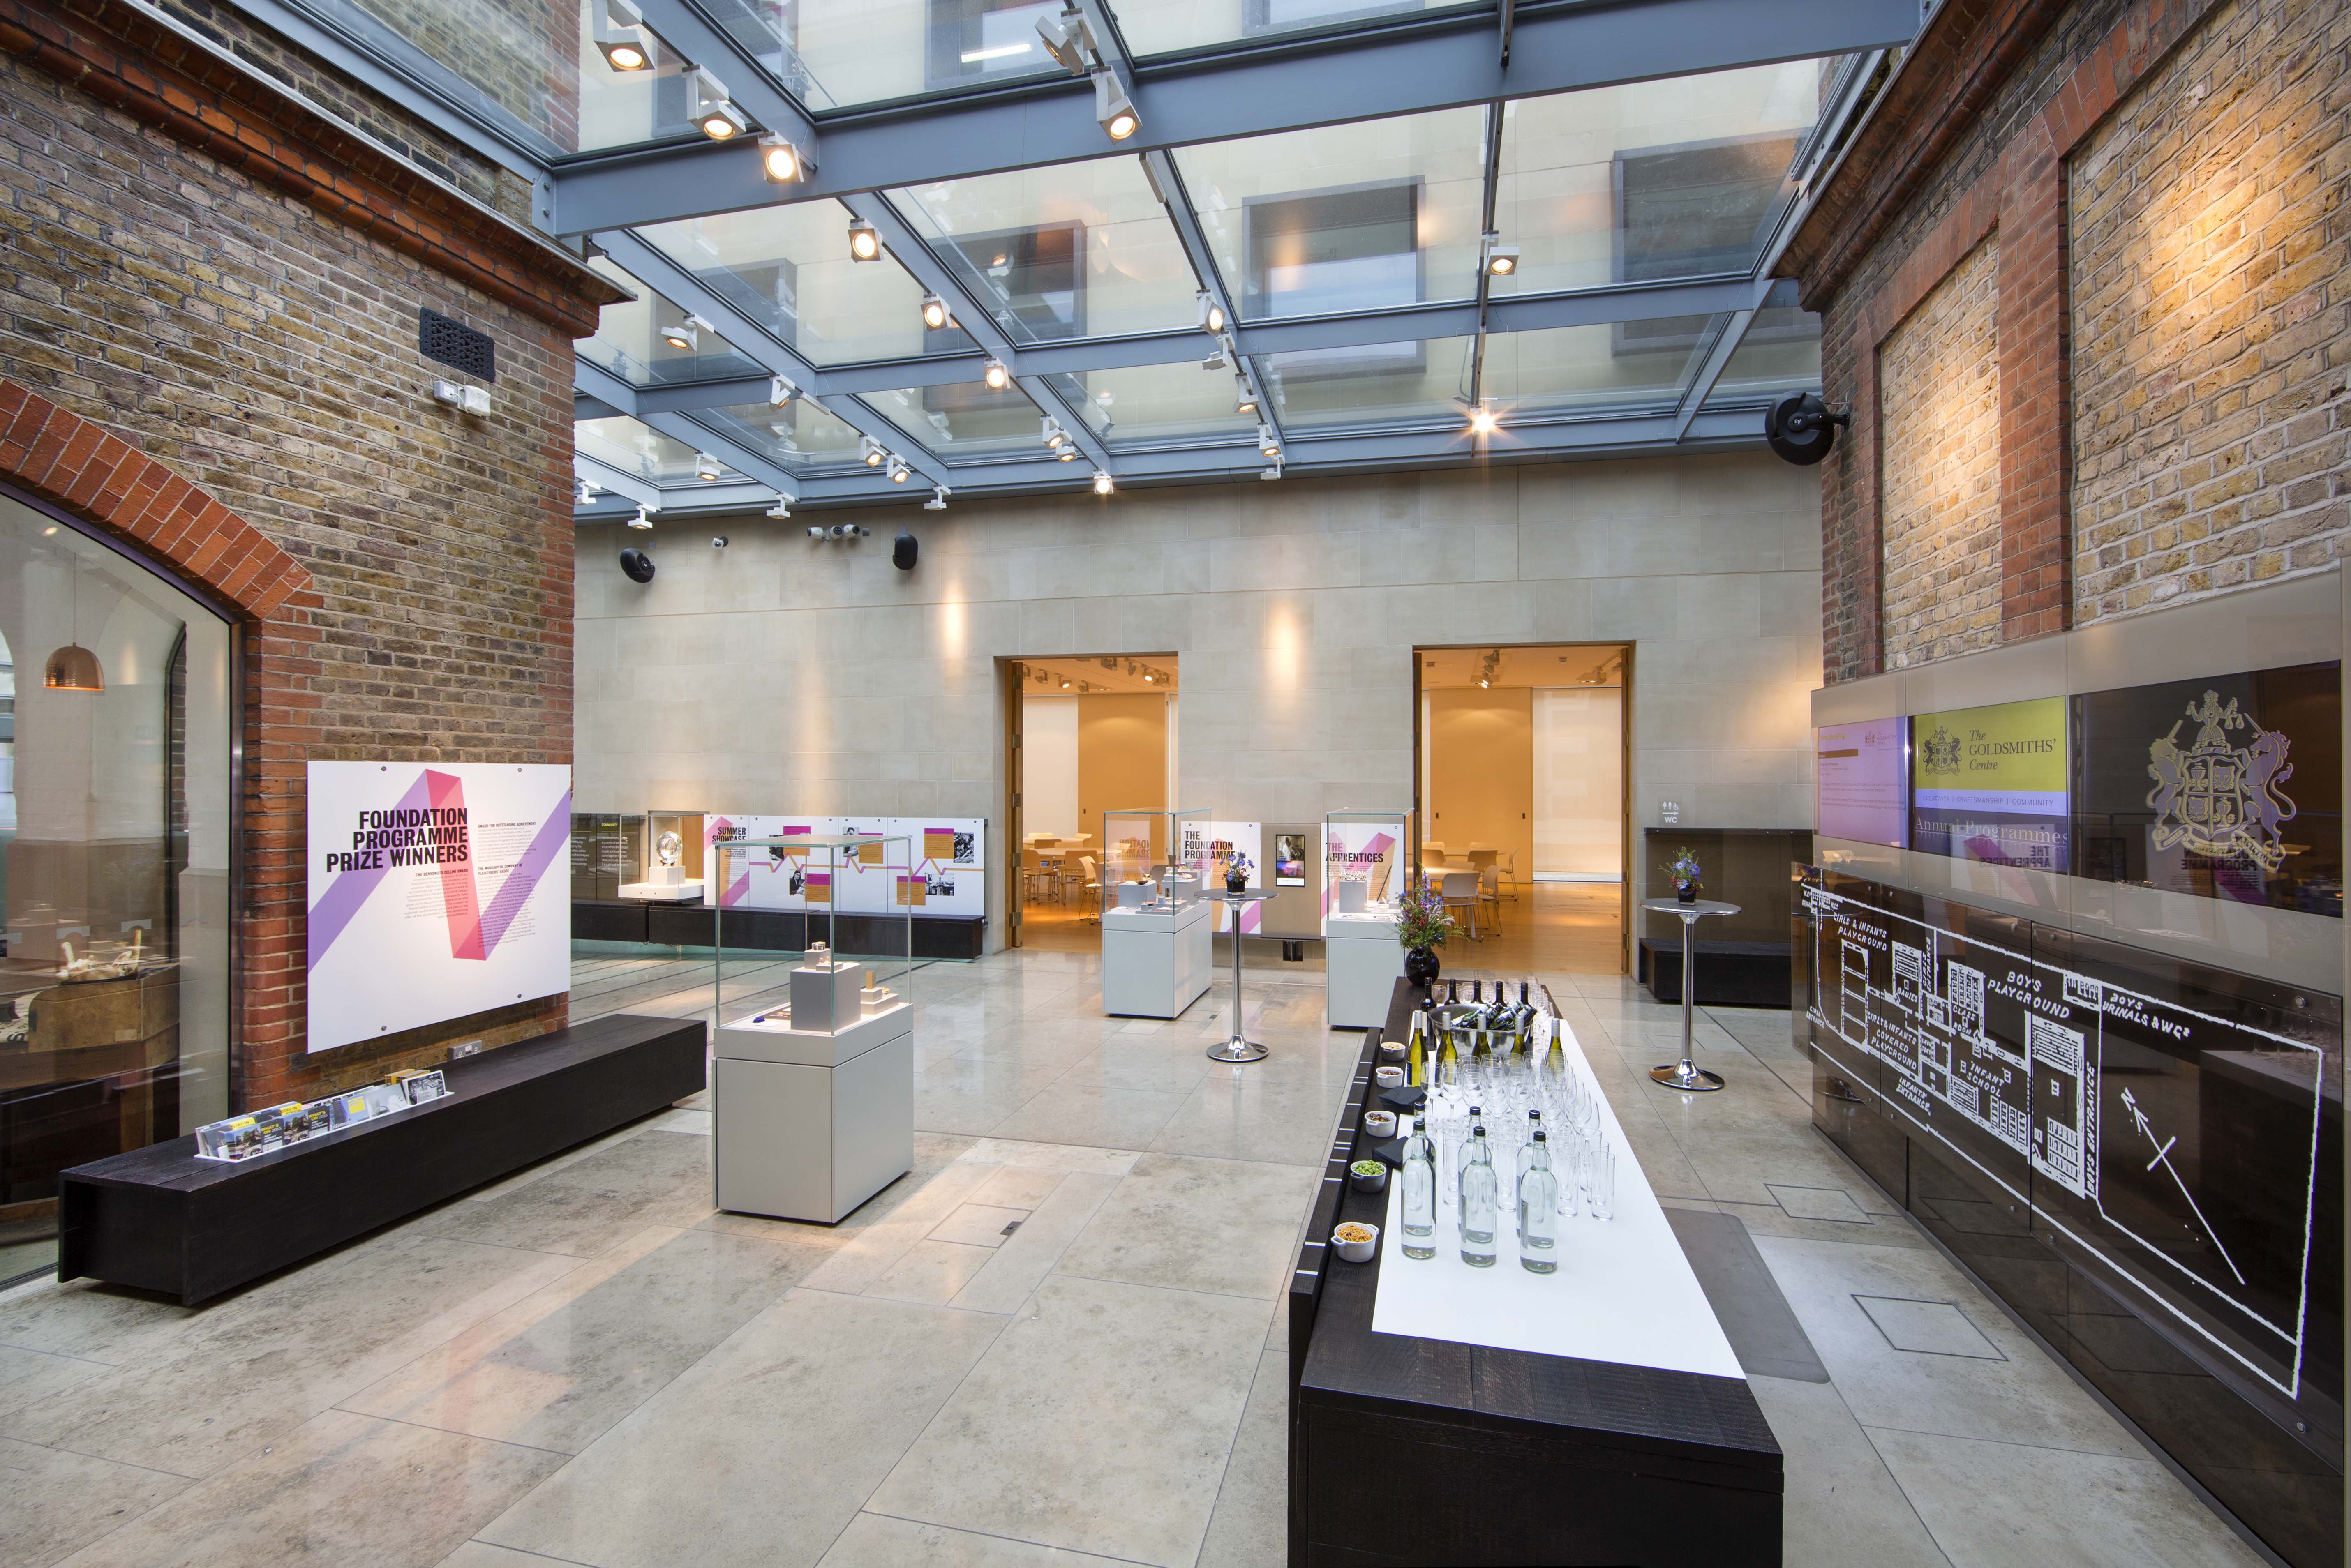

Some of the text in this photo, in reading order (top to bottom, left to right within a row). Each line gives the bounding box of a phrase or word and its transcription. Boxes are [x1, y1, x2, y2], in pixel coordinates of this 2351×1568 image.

[1969, 729, 1986, 741] The
[1969, 759, 1998, 770] Centre
[2012, 798, 2054, 806] COMMUNITY
[359, 808, 467, 829] FOUNDATION
[1915, 816, 1961, 833] Annual
[353, 826, 468, 850] PROGRAMME
[718, 827, 746, 835] SUMMER
[1185, 831, 1200, 840] THE
[1185, 840, 1233, 850] FOUNDATION
[1185, 850, 1235, 859] PROGRAMME
[1326, 842, 1343, 852] THE
[327, 850, 383, 873] PRIZE
[390, 844, 468, 867] WINNERS
[1326, 853, 1383, 863] APPRENTICES
[1834, 912, 1887, 938] GIRLS & INFANTS
[1837, 926, 1887, 951] PLAYGROUND
[1897, 987, 1918, 1003] BABIES
[1987, 979, 2070, 1018] PLAYGROUND
[1953, 1005, 1976, 1021] CLASS
[2102, 1001, 2149, 1027] URINALS
[1867, 1012, 1884, 1025] GIRLS
[1889, 1022, 1917, 1045] INFANTS
[1953, 1022, 1972, 1035] ROOM
[1876, 1029, 1909, 1053] COVERED
[1871, 1036, 1917, 1070] PLAYGROUND
[1970, 1061, 2004, 1087] INFANT
[1967, 1072, 2001, 1097] SCHOOL
[2087, 1061, 2095, 1194] BOYS ENTRANCE
